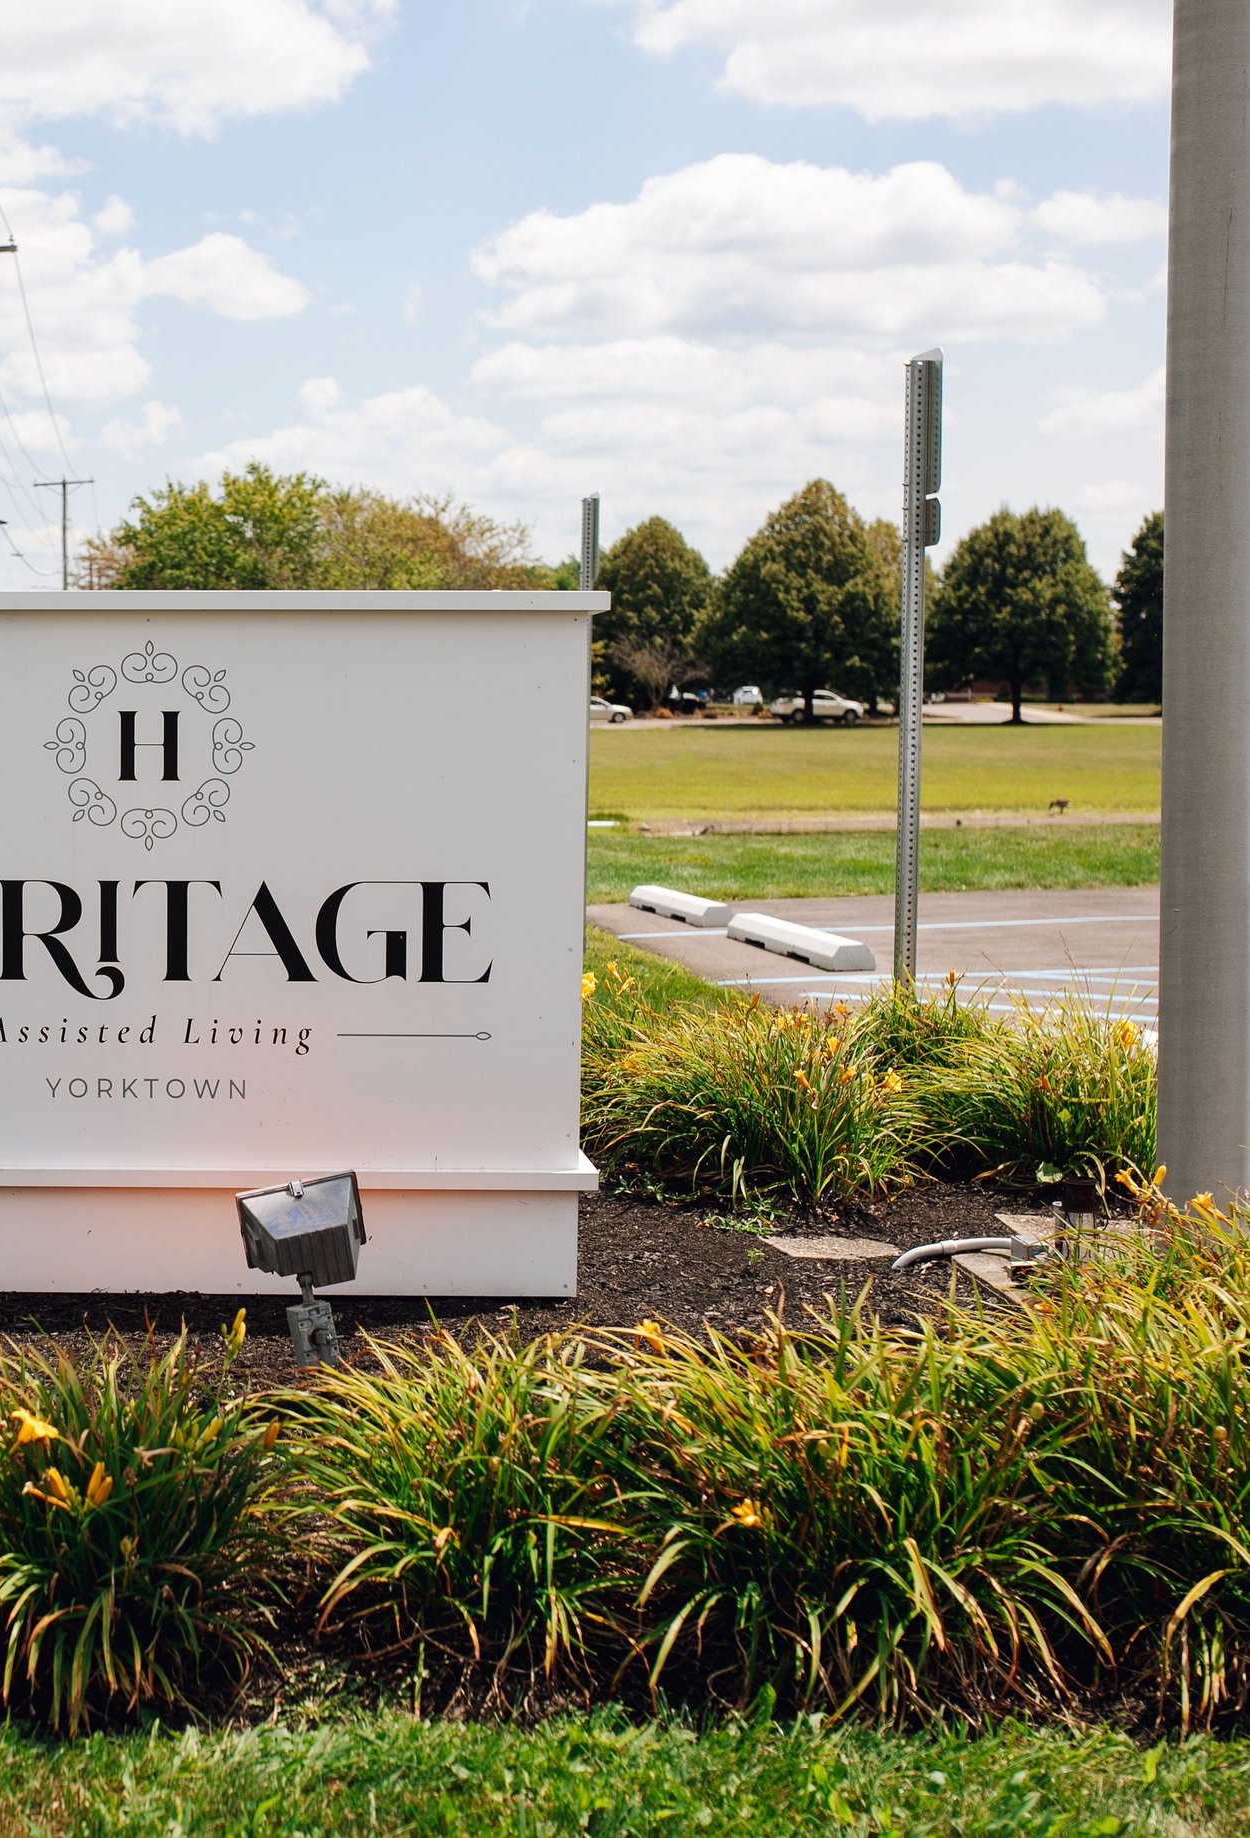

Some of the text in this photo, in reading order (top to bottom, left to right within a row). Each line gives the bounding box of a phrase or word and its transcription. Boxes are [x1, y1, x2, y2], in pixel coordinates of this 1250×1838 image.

[117, 710, 182, 782] H
[182, 1017, 313, 1056] Living
[45, 1077, 248, 1101] YORKTOWN
